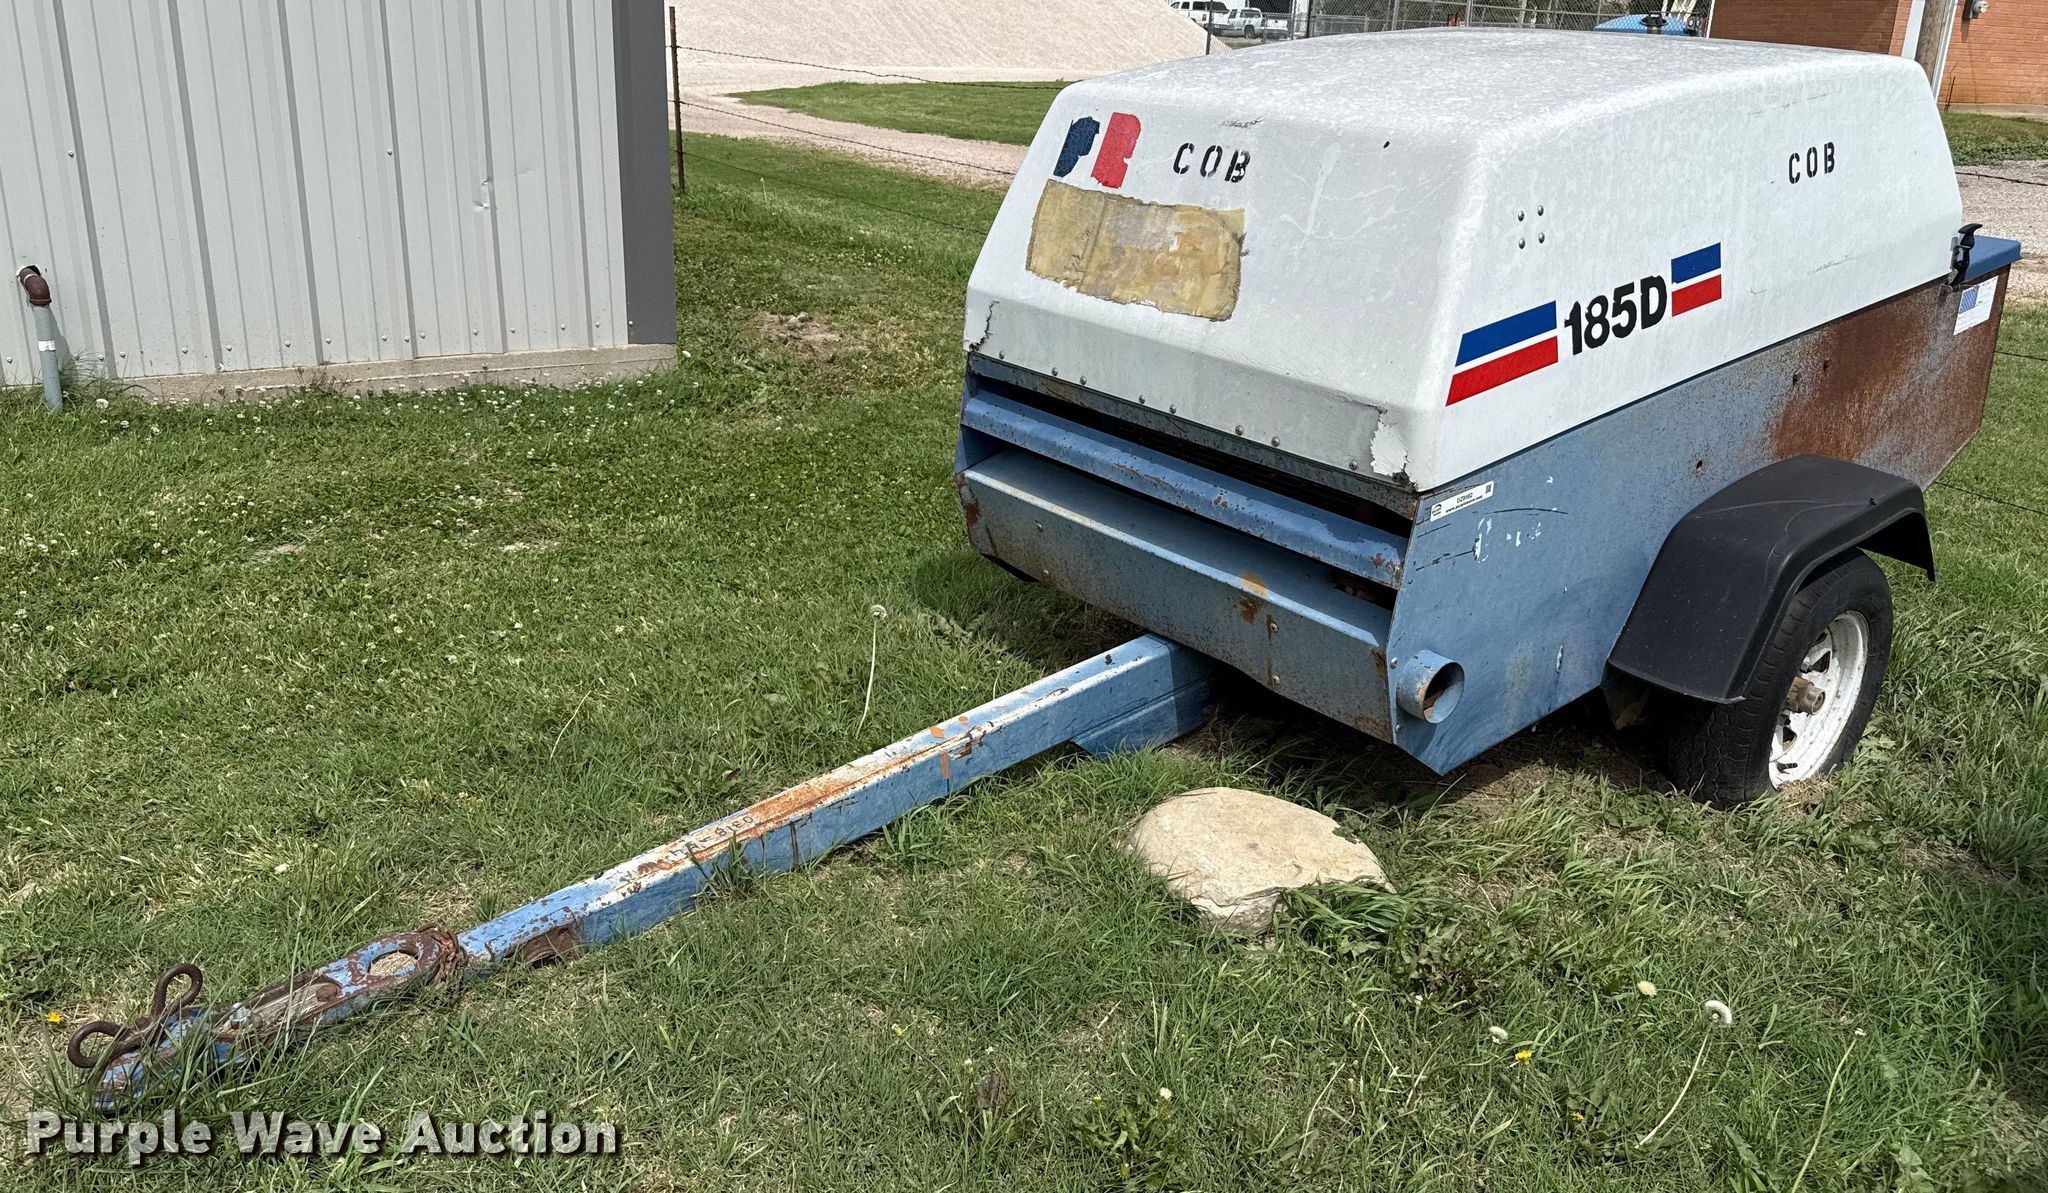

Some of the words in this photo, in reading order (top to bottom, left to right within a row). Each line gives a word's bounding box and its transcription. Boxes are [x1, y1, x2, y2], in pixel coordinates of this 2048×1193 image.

[1173, 142, 1251, 183] COB
[1788, 141, 1836, 184] COB
[1564, 275, 1668, 356] 185D
